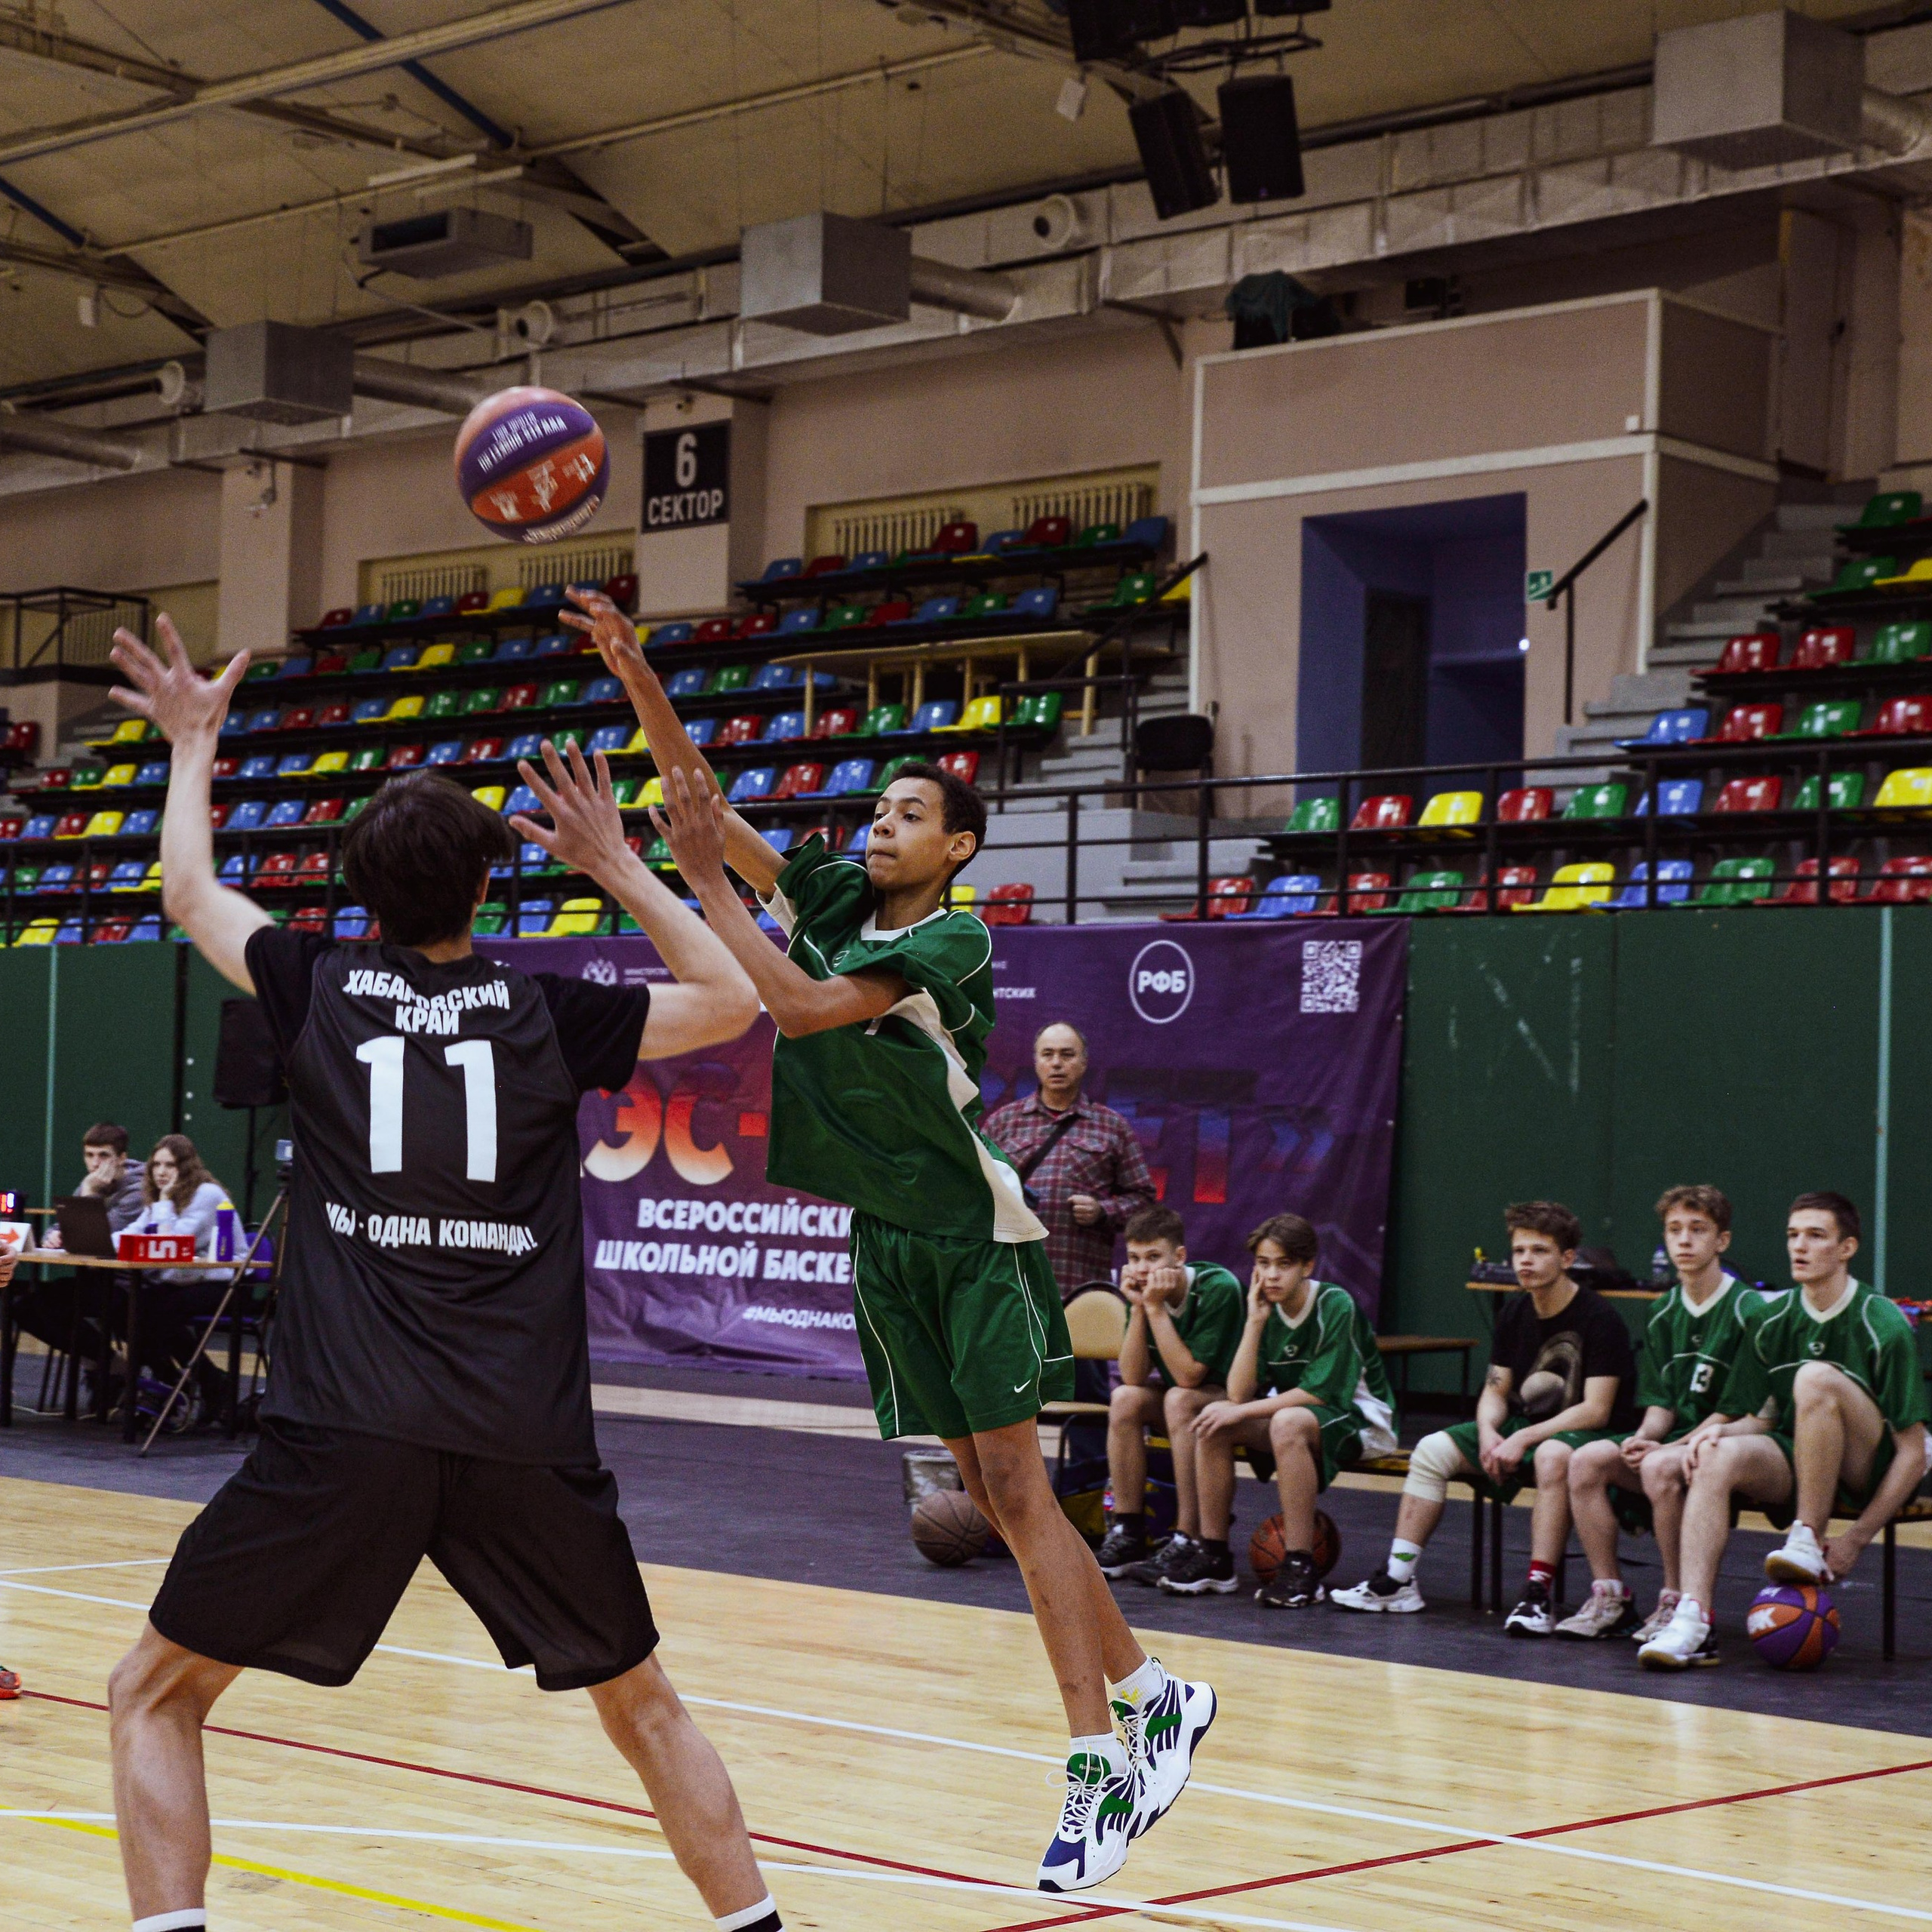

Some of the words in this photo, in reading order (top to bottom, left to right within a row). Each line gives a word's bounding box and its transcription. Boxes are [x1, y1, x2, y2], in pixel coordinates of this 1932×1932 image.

[675, 432, 698, 487] 6
[647, 488, 724, 525] СЕКТОР
[1137, 971, 1186, 993] РФБ
[355, 1035, 497, 1183] 11
[368, 1214, 432, 1248] ОДНА
[438, 1219, 538, 1257] КОМАНДА!
[637, 1197, 851, 1238] ВСЕРОССИЙСКИ
[594, 1240, 759, 1278] ШКОЛЬНОЙ
[762, 1250, 855, 1284] БАСКЕ
[743, 1306, 857, 1331] #МЫОДНАКО
